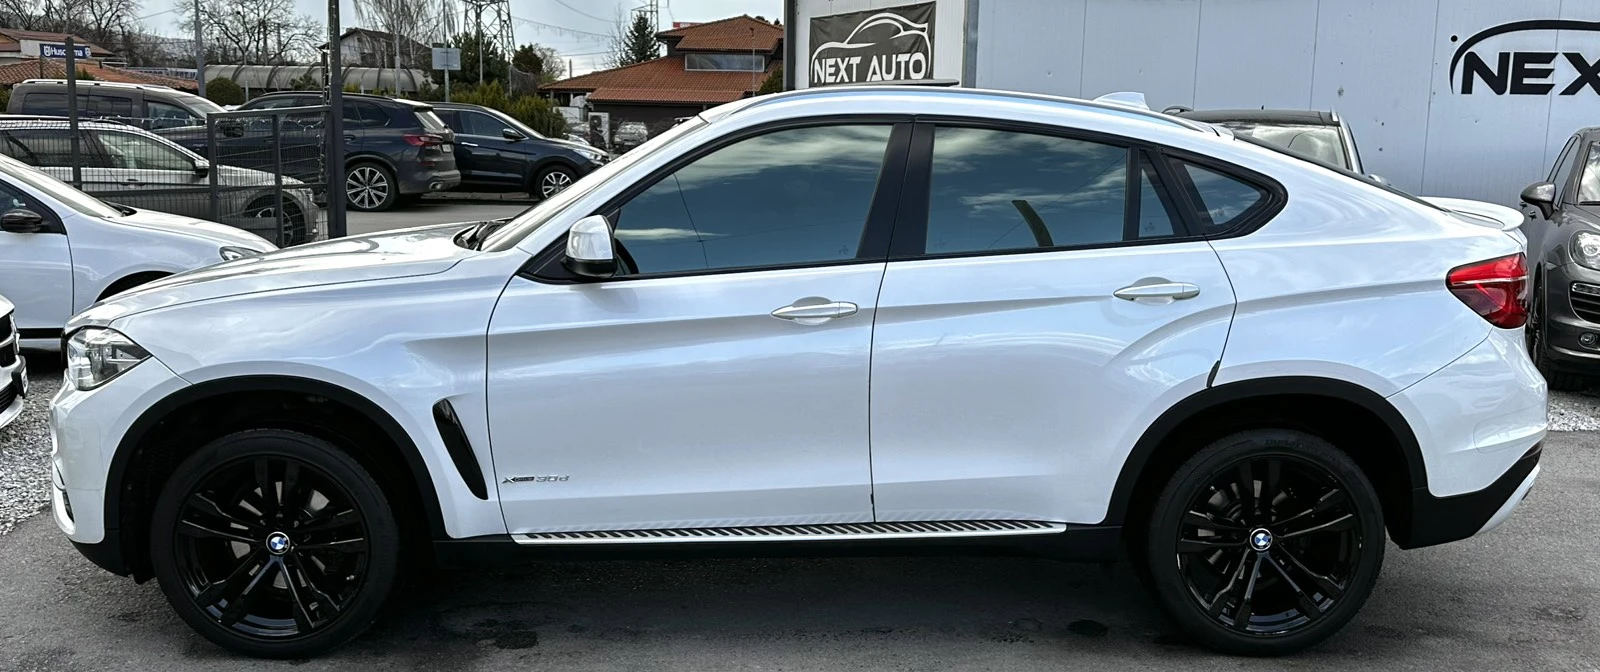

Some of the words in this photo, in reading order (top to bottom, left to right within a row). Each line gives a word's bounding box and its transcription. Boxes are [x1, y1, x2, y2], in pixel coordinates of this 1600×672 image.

[50, 47, 83, 57] Husna
[814, 56, 862, 83] NEXT
[866, 52, 926, 82] AUTO
[1460, 51, 1600, 96] NEX
